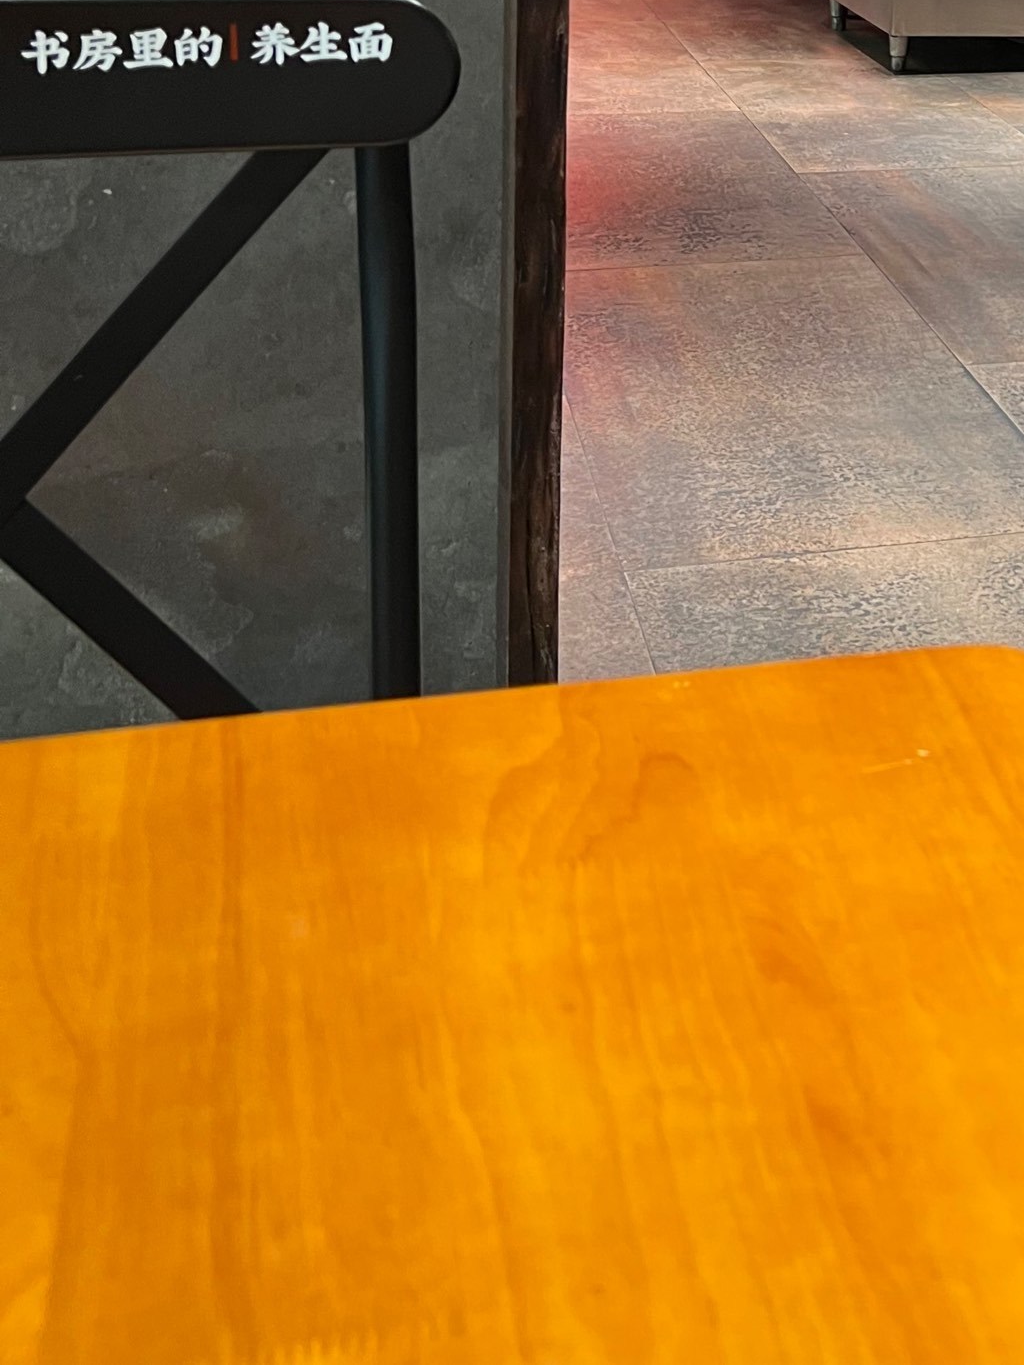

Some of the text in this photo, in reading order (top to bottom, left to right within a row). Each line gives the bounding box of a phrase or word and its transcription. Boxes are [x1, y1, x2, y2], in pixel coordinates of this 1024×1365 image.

[20, 21, 393, 75] 书房里的 养生面
